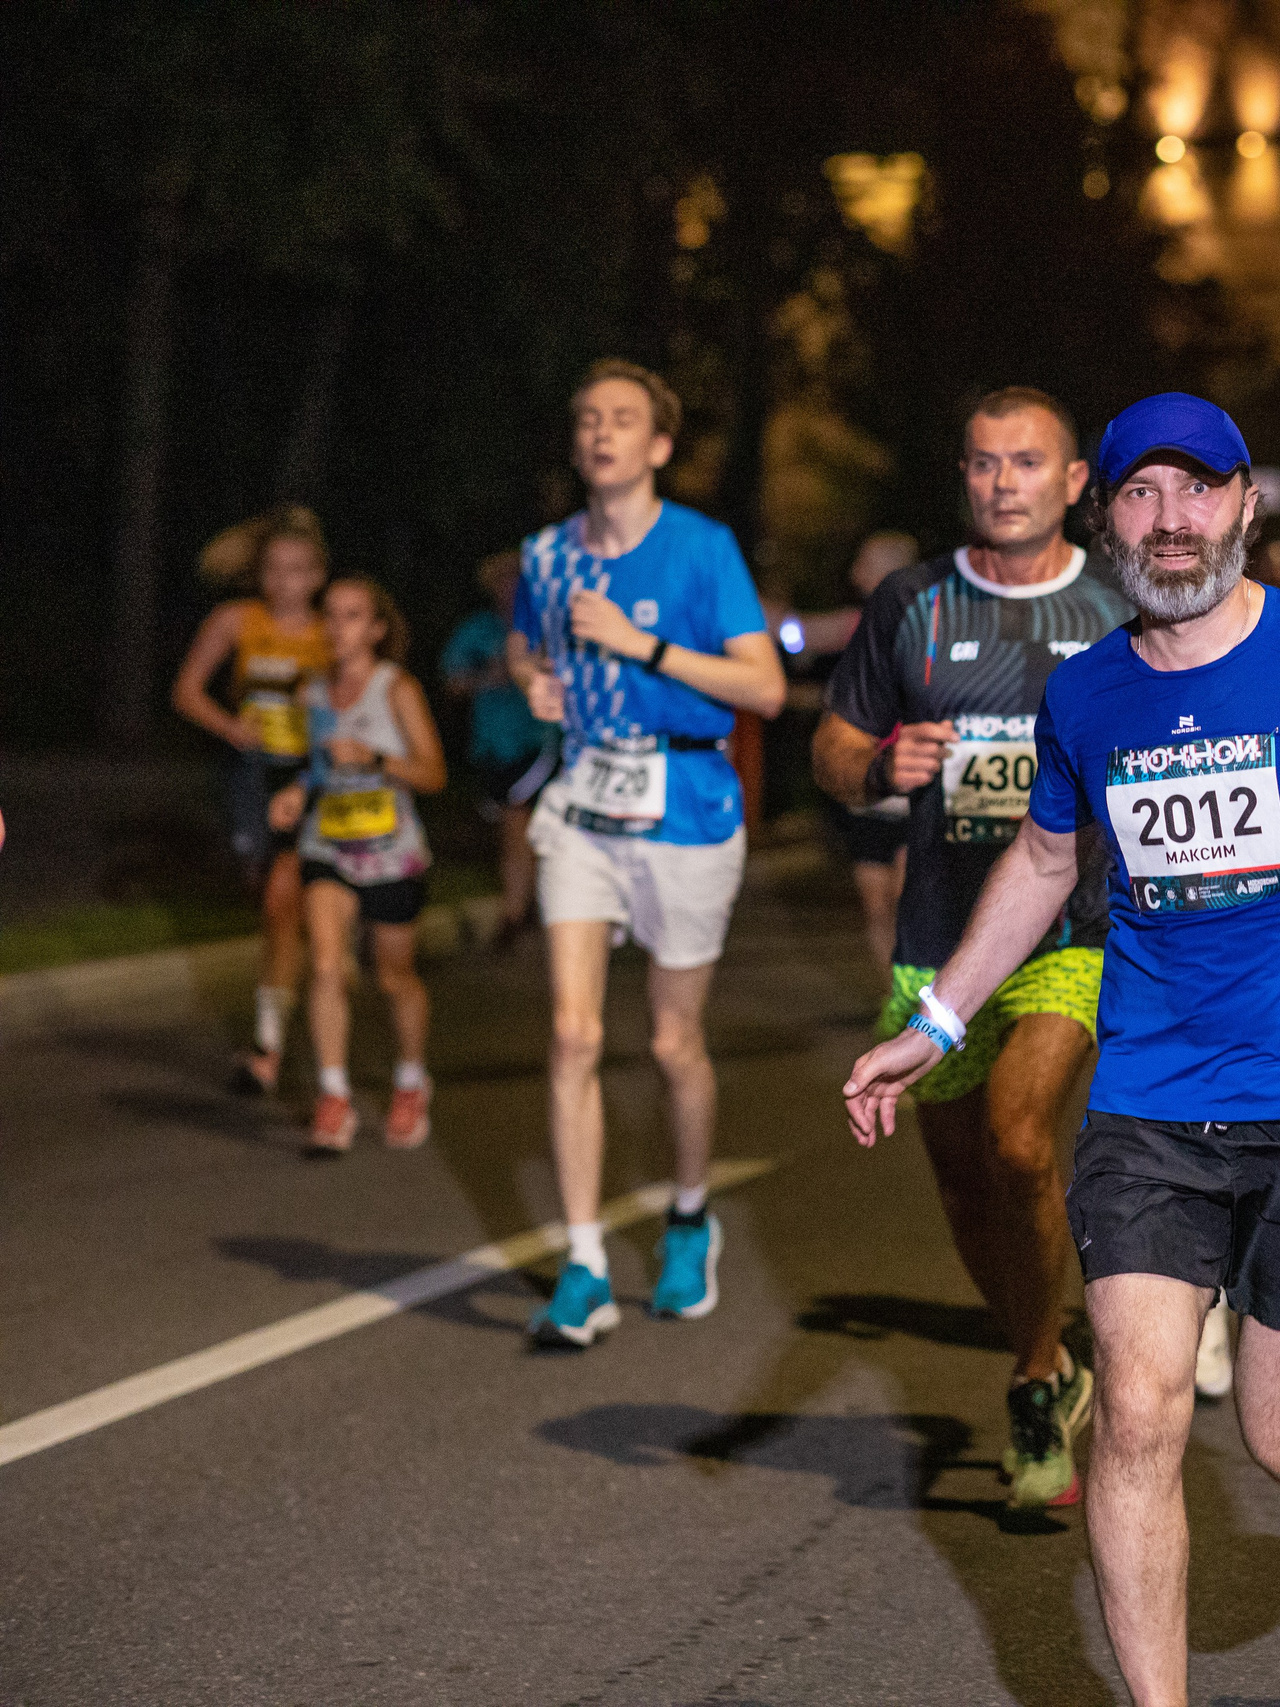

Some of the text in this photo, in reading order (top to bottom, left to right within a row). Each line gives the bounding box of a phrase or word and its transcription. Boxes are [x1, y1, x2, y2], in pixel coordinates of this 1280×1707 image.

[1171, 726, 1202, 735] NORDSKI
[1122, 735, 1263, 775] НОЧНОЙ
[1131, 786, 1263, 847] 2012
[1165, 844, 1237, 865] МАКСИМ
